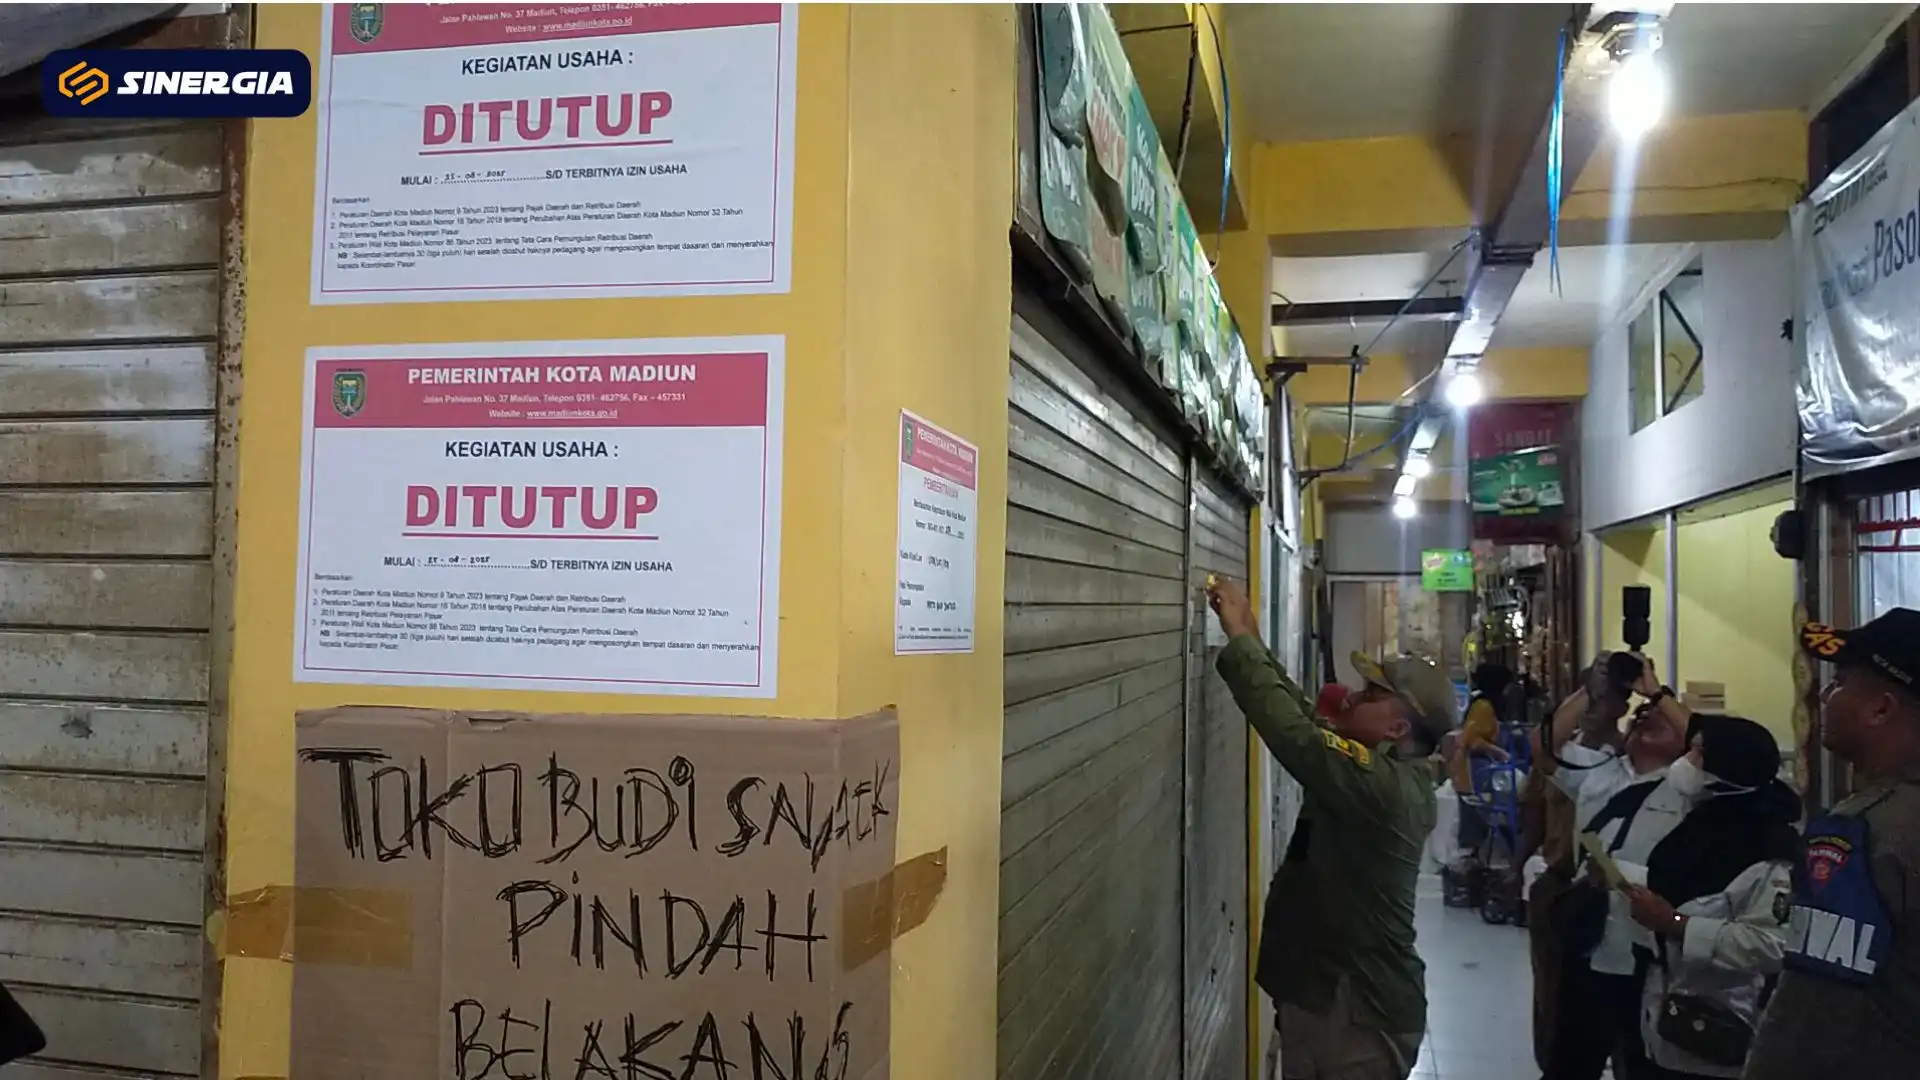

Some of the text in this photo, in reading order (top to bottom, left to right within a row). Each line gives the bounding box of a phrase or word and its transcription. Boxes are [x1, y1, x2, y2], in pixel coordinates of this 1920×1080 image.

[462, 53, 552, 76] KEGIATAN
[558, 50, 623, 70] USAHA
[422, 92, 672, 144] DITUTUP
[400, 175, 432, 186] MULAI
[544, 170, 562, 179] S/D
[565, 167, 623, 178] TERBITNYA
[626, 166, 644, 176] IZIN
[648, 164, 688, 175] USAHA
[1874, 187, 1920, 284] Paso
[408, 364, 696, 385] PEMERINTAH KOTA MADIUN
[632, 392, 648, 401] Fax
[656, 392, 686, 401] 457331
[445, 440, 536, 459] KEGIATAN
[542, 440, 608, 459] USAHA
[406, 485, 659, 530] DITUTUP
[384, 556, 415, 567] MULAI
[530, 559, 547, 569] S/D
[550, 559, 608, 571] TERBITNYA
[611, 560, 630, 571] IZIN
[634, 560, 672, 572] USAHA
[299, 746, 522, 862] TOKO
[716, 757, 890, 873] SNACK
